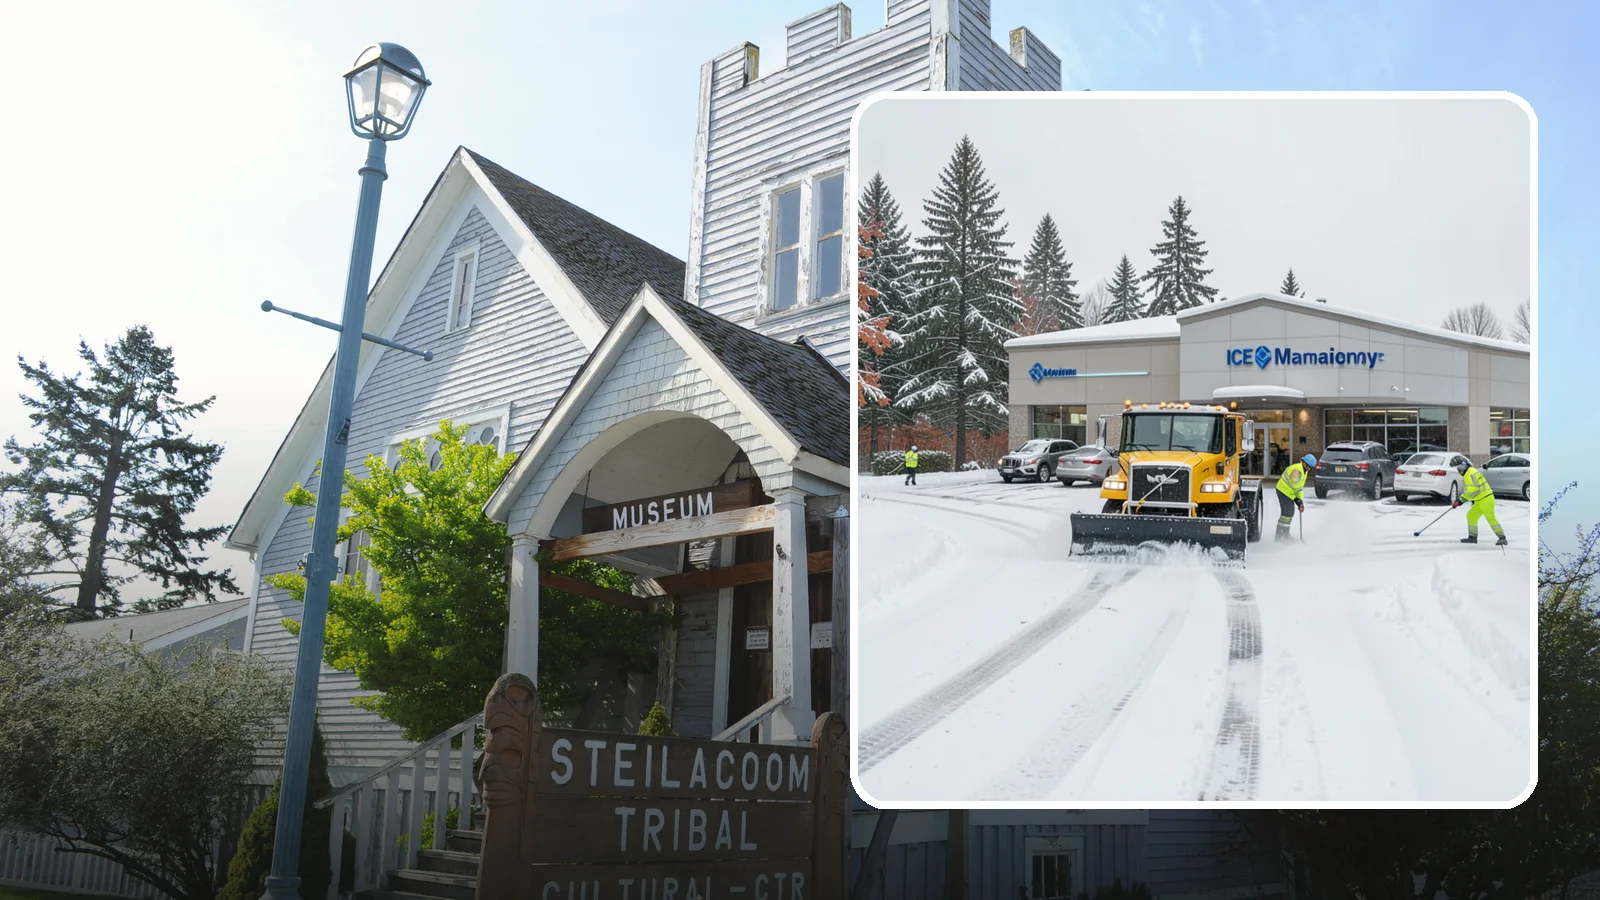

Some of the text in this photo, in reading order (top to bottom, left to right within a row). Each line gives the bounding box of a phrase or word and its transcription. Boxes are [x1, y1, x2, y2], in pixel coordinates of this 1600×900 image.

[1226, 348, 1253, 366] ICE
[612, 491, 713, 531] MUSEUM
[550, 738, 809, 793] STEILACOOM
[615, 806, 757, 852] TRIBAL
